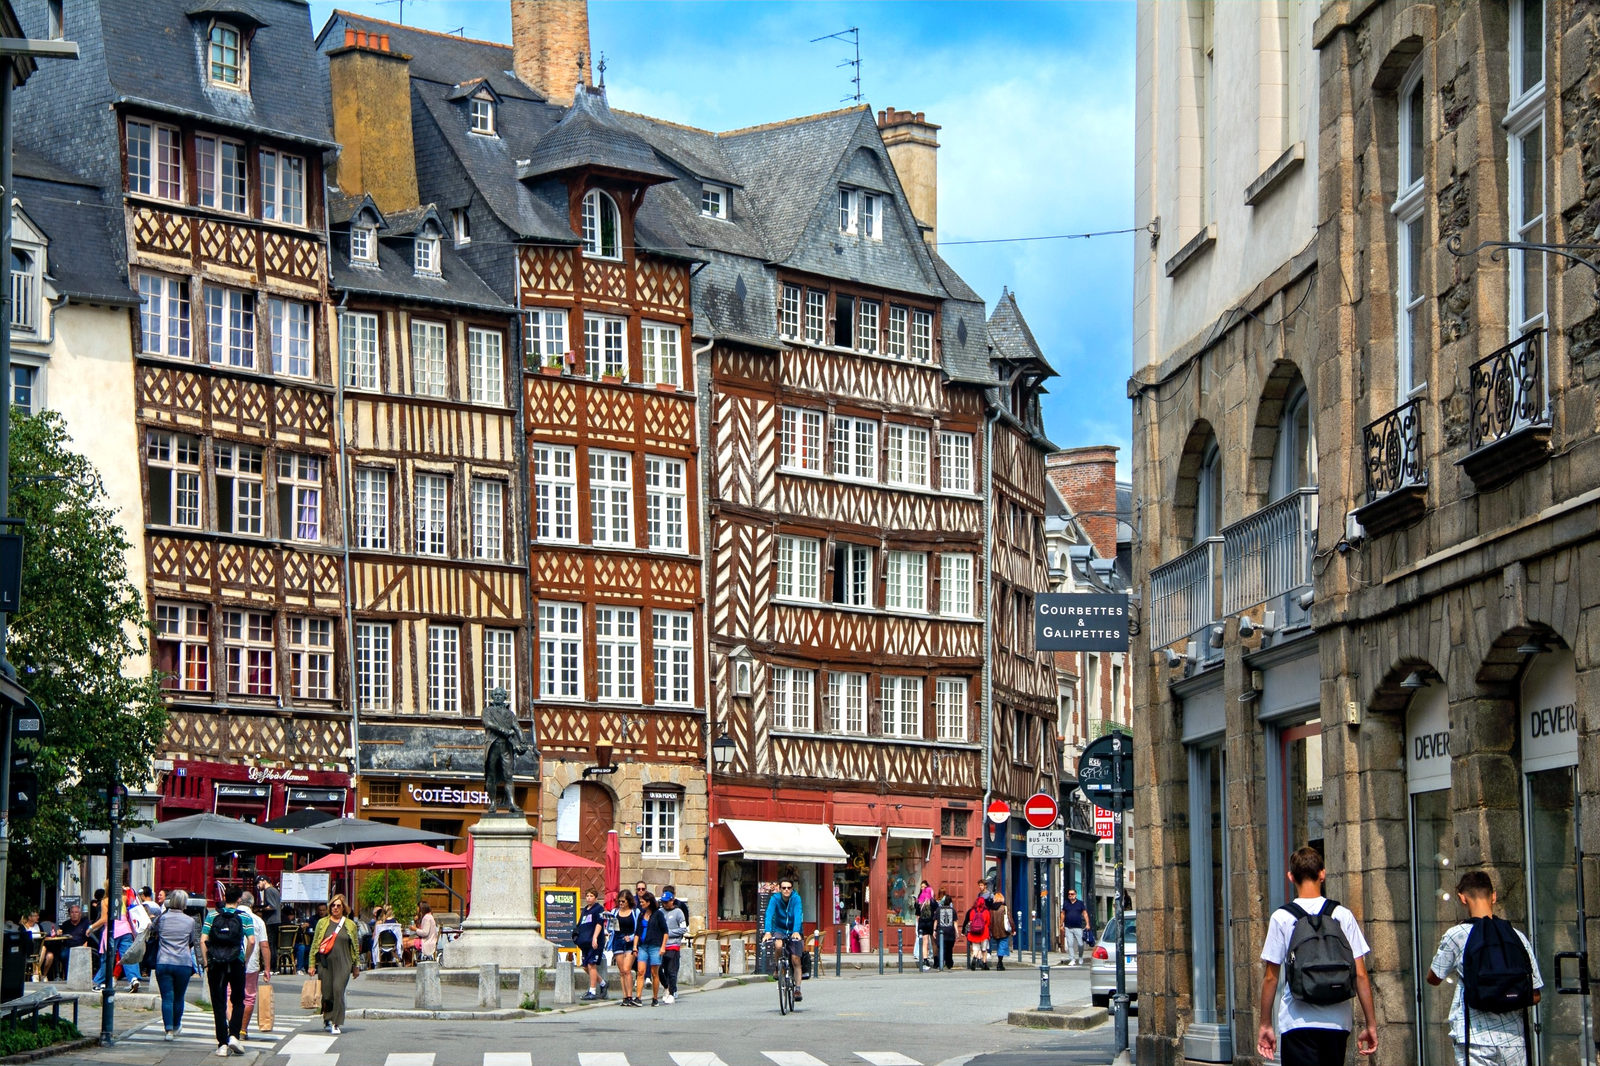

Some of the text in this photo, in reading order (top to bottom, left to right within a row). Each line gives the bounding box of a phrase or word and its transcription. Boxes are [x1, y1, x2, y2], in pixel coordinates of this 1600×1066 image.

[1039, 603, 1124, 616] COURBETTES
[1077, 618, 1085, 627] &
[1042, 626, 1121, 639] GALIPETTES
[1530, 702, 1578, 739] DEVER
[279, 769, 309, 782] Maman
